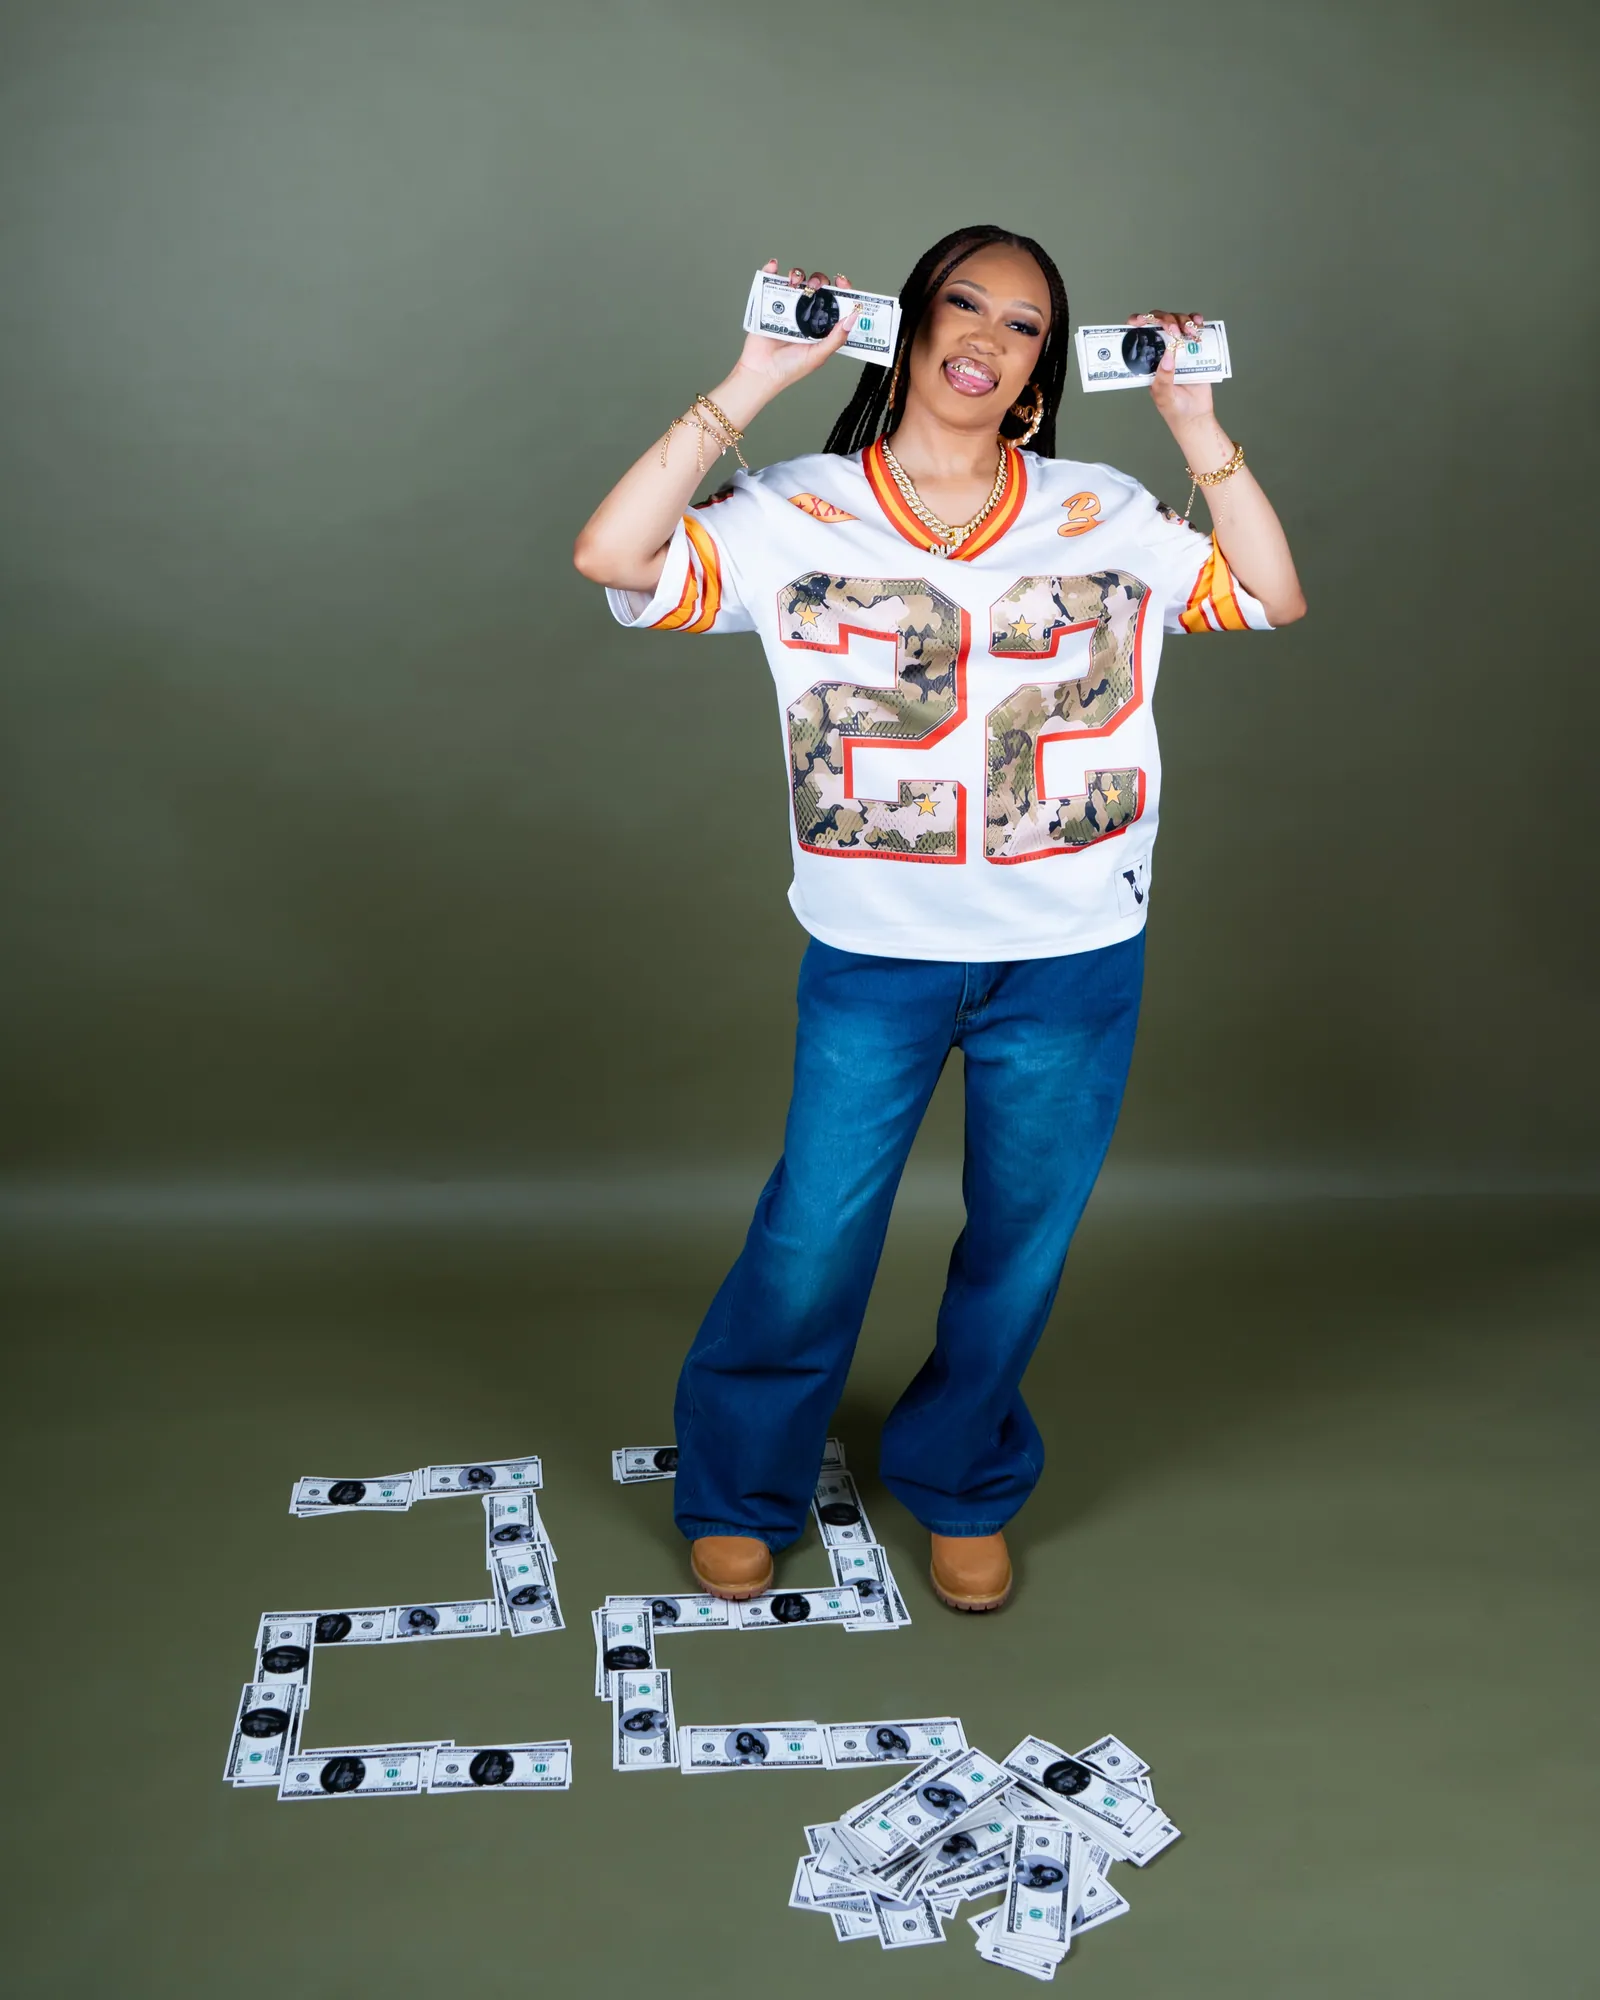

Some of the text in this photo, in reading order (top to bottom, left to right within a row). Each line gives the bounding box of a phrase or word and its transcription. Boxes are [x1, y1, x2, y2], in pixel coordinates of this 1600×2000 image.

[864, 336, 886, 346] 100
[1196, 358, 1217, 366] 100
[777, 570, 1152, 866] 22
[1015, 1911, 1023, 1930] 100
